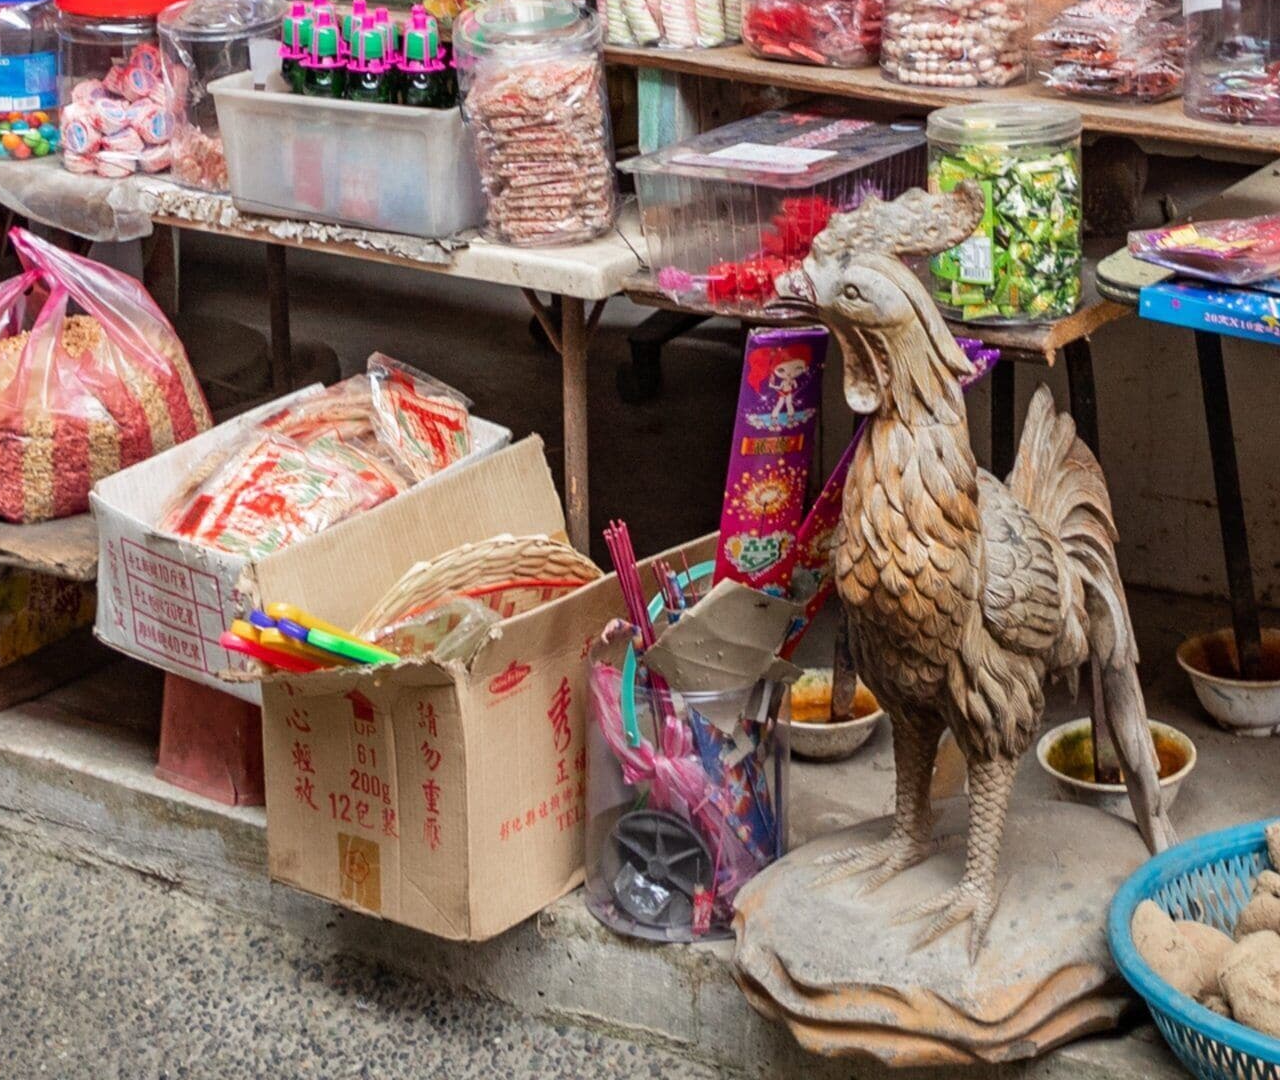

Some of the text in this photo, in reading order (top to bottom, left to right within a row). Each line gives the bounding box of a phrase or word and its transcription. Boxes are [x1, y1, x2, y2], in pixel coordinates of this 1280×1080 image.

[354, 719, 377, 736] UP
[349, 768, 391, 806] 200g
[417, 700, 443, 853] 請勿重壓
[328, 791, 401, 840] 12包裝
